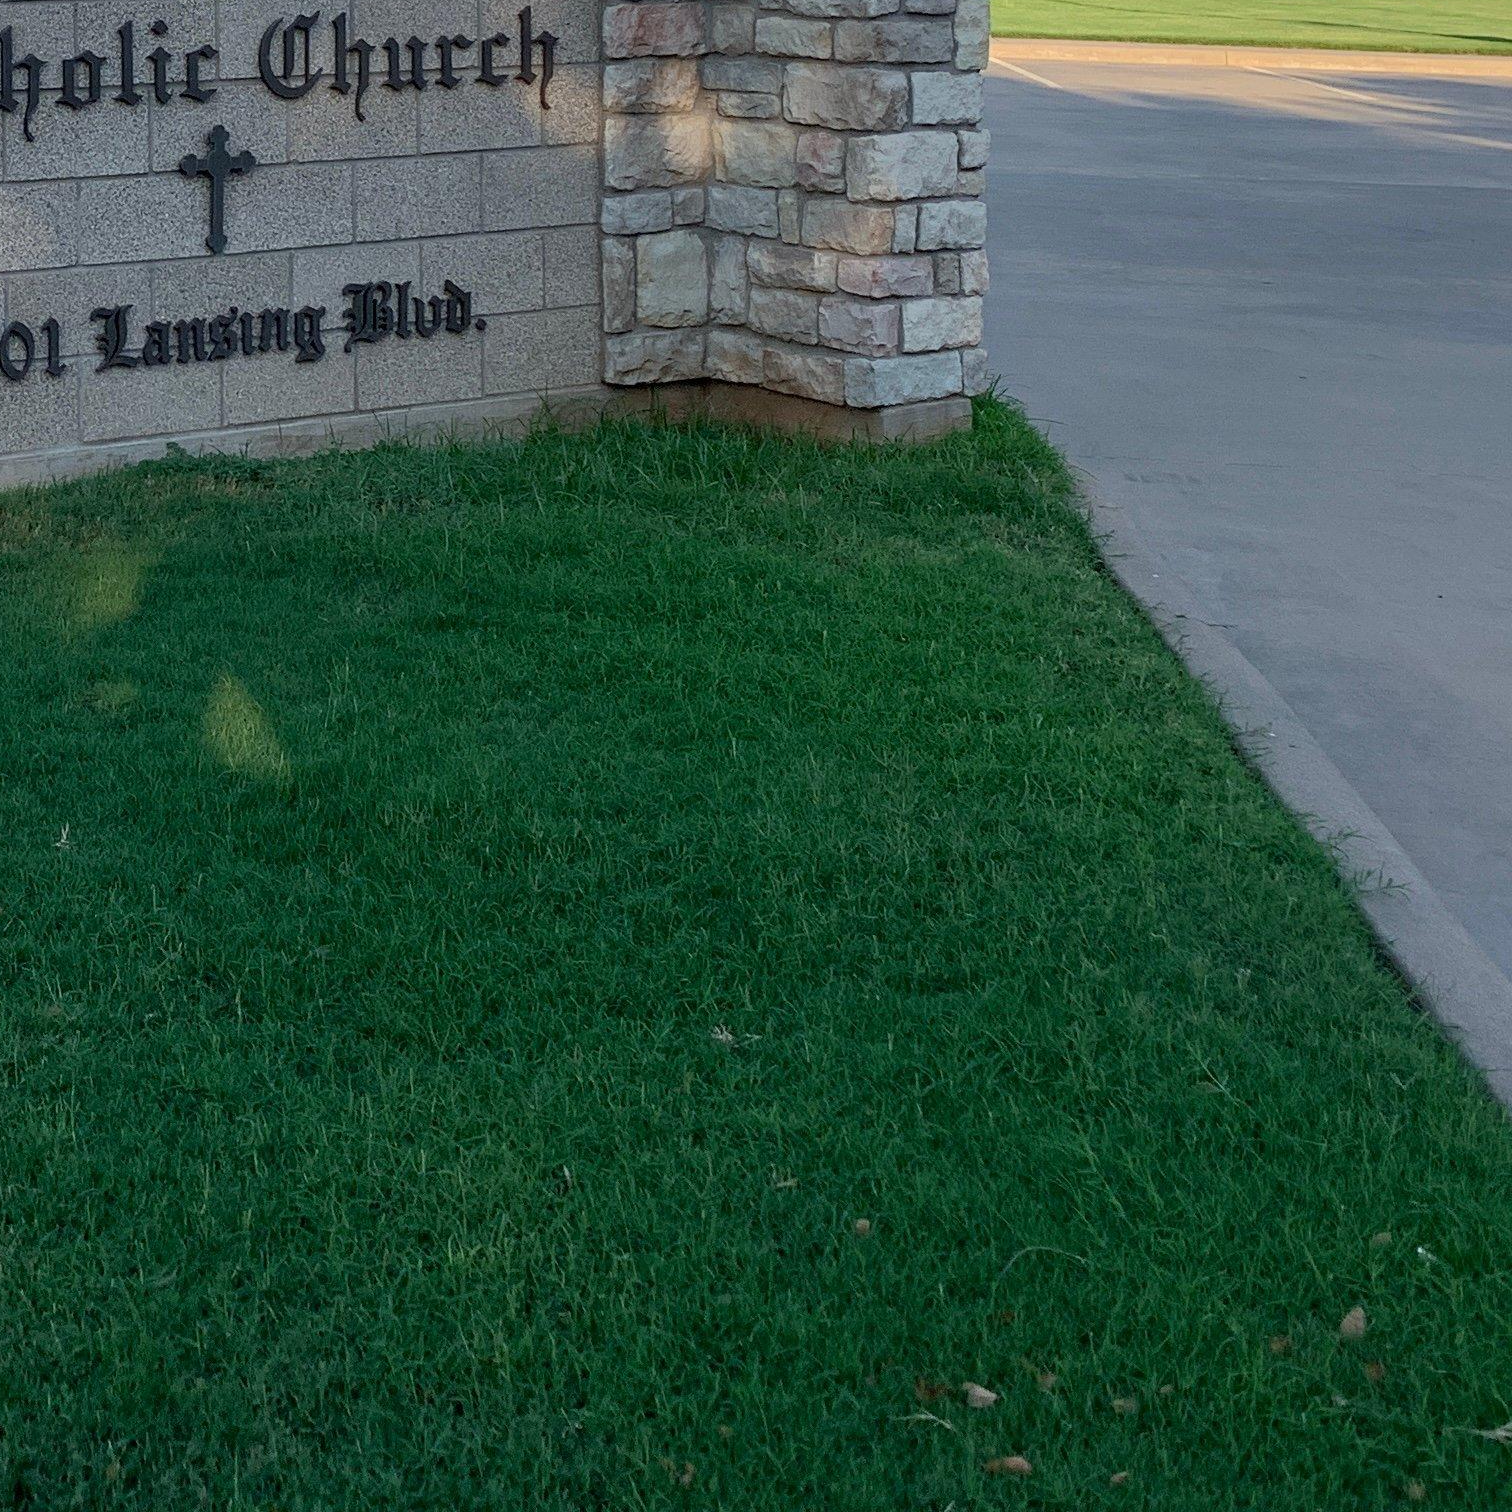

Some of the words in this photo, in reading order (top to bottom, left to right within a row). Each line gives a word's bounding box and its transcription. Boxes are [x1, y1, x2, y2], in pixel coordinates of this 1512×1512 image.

[258, 6, 560, 120] Church
[90, 302, 324, 371] Lansing
[342, 278, 487, 352] Blvd.
